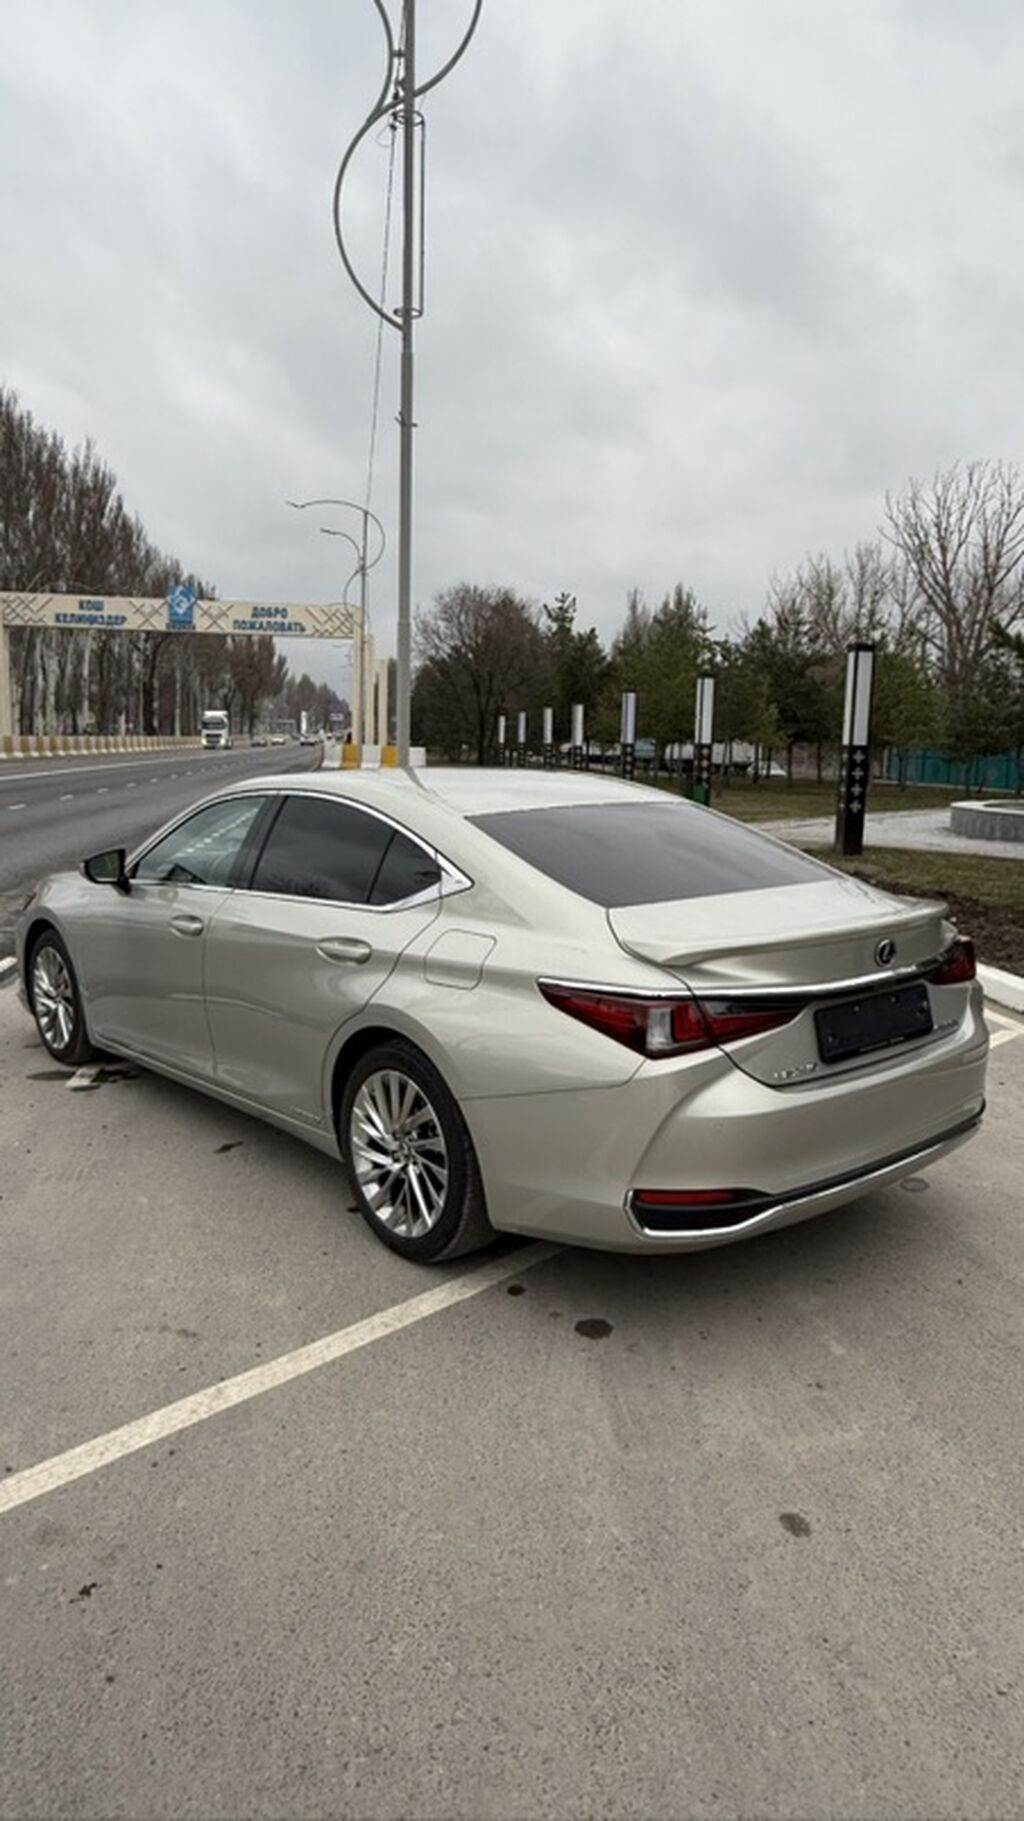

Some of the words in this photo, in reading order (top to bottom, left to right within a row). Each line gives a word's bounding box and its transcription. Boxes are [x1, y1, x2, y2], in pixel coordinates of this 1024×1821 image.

[78, 600, 105, 611] КОШ
[251, 606, 288, 619] ДОБРО
[233, 619, 306, 632] ПОЖАЛОВАТЬ
